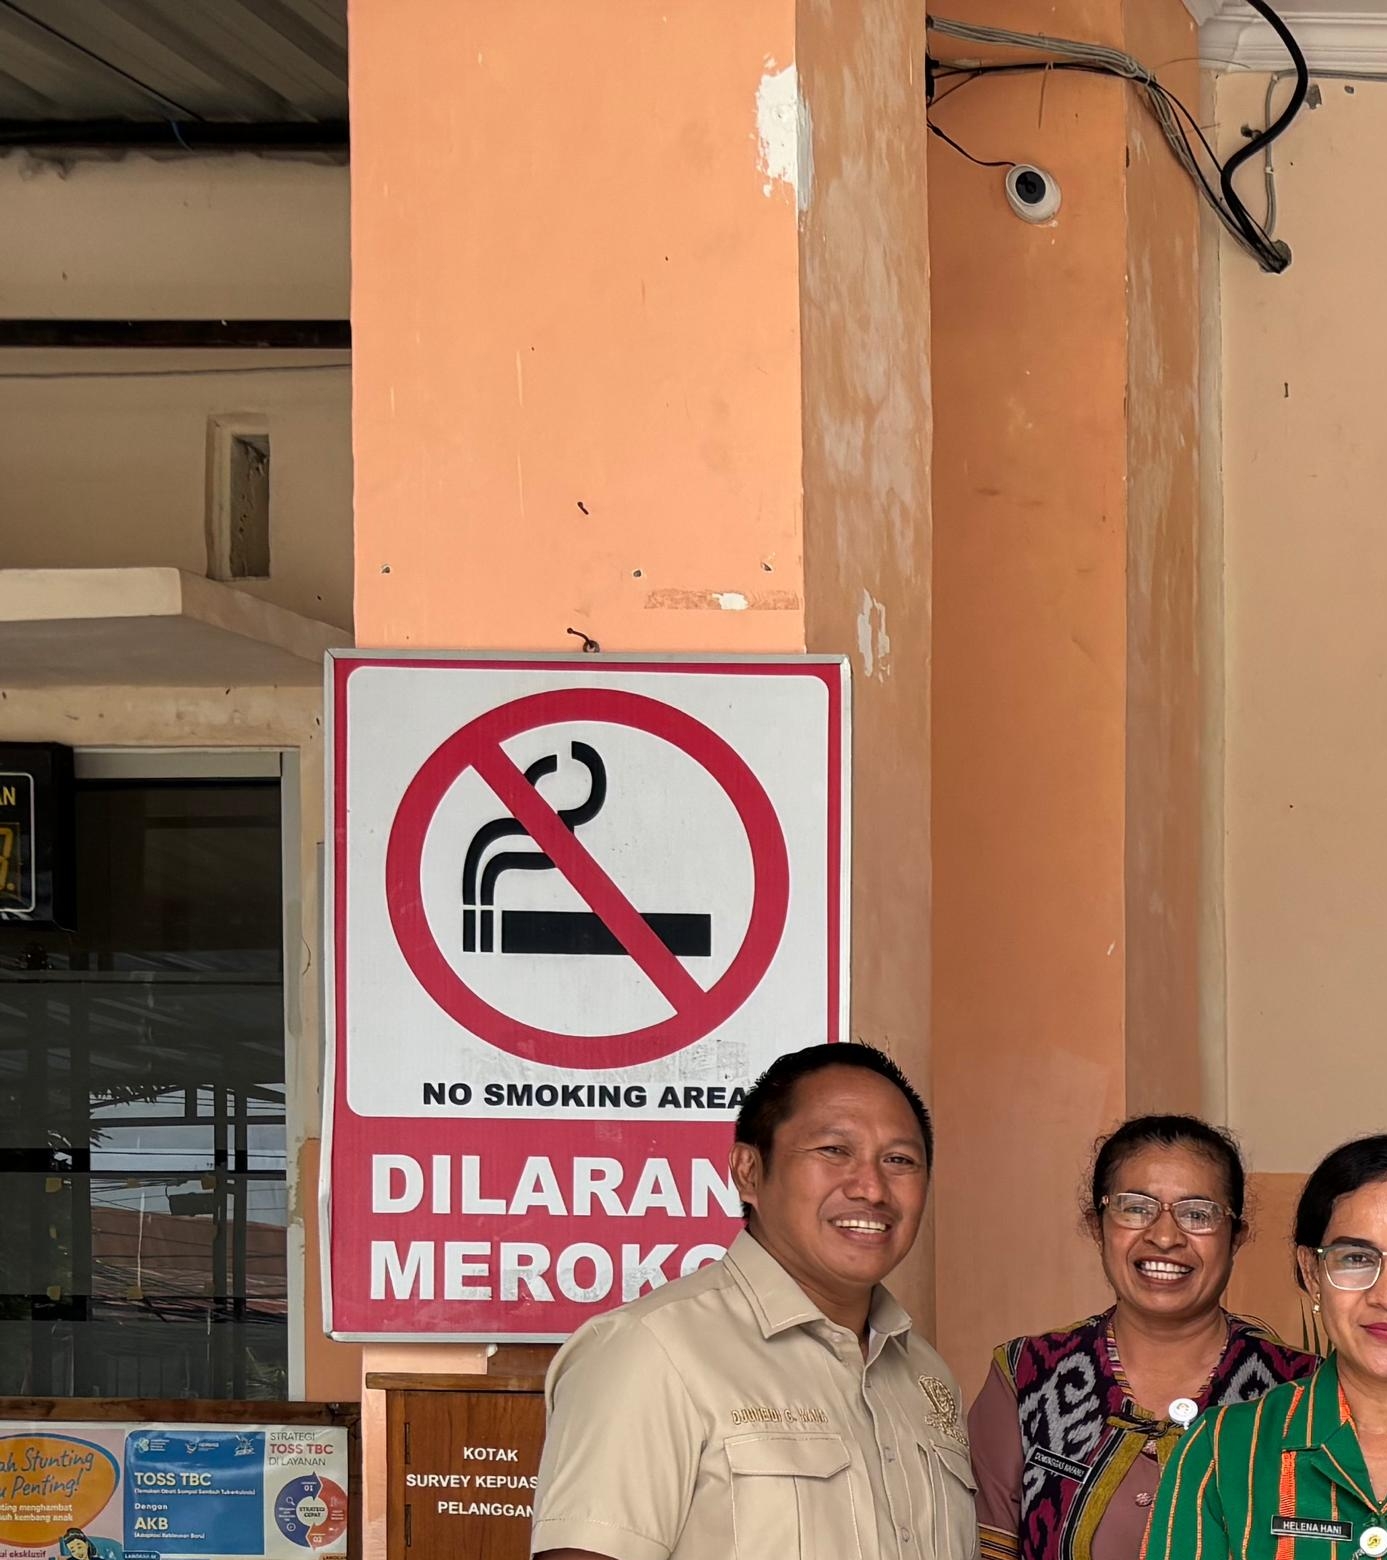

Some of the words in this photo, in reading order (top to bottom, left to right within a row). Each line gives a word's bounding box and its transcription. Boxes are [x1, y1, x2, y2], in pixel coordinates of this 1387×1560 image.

[423, 1082, 472, 1105] NO
[484, 1083, 647, 1109] SMOKING
[658, 1086, 748, 1110] AREA
[270, 1432, 315, 1441] STRATEGI
[269, 1444, 303, 1454] TOSS
[307, 1444, 334, 1454] TBC
[463, 1446, 518, 1462] KOTAK
[21, 1447, 94, 1472] Stunting
[281, 1457, 326, 1466] LAYANAN
[11, 1468, 84, 1500] Penting!
[134, 1472, 176, 1486] TOSS
[180, 1472, 212, 1486] TBC
[406, 1474, 470, 1487] SURVEY
[475, 1475, 539, 1490] KEPUAS
[134, 1503, 168, 1511] Dengan
[134, 1517, 169, 1530] AKB
[1283, 1521, 1319, 1532] HELENA
[1320, 1525, 1342, 1534] HANI
